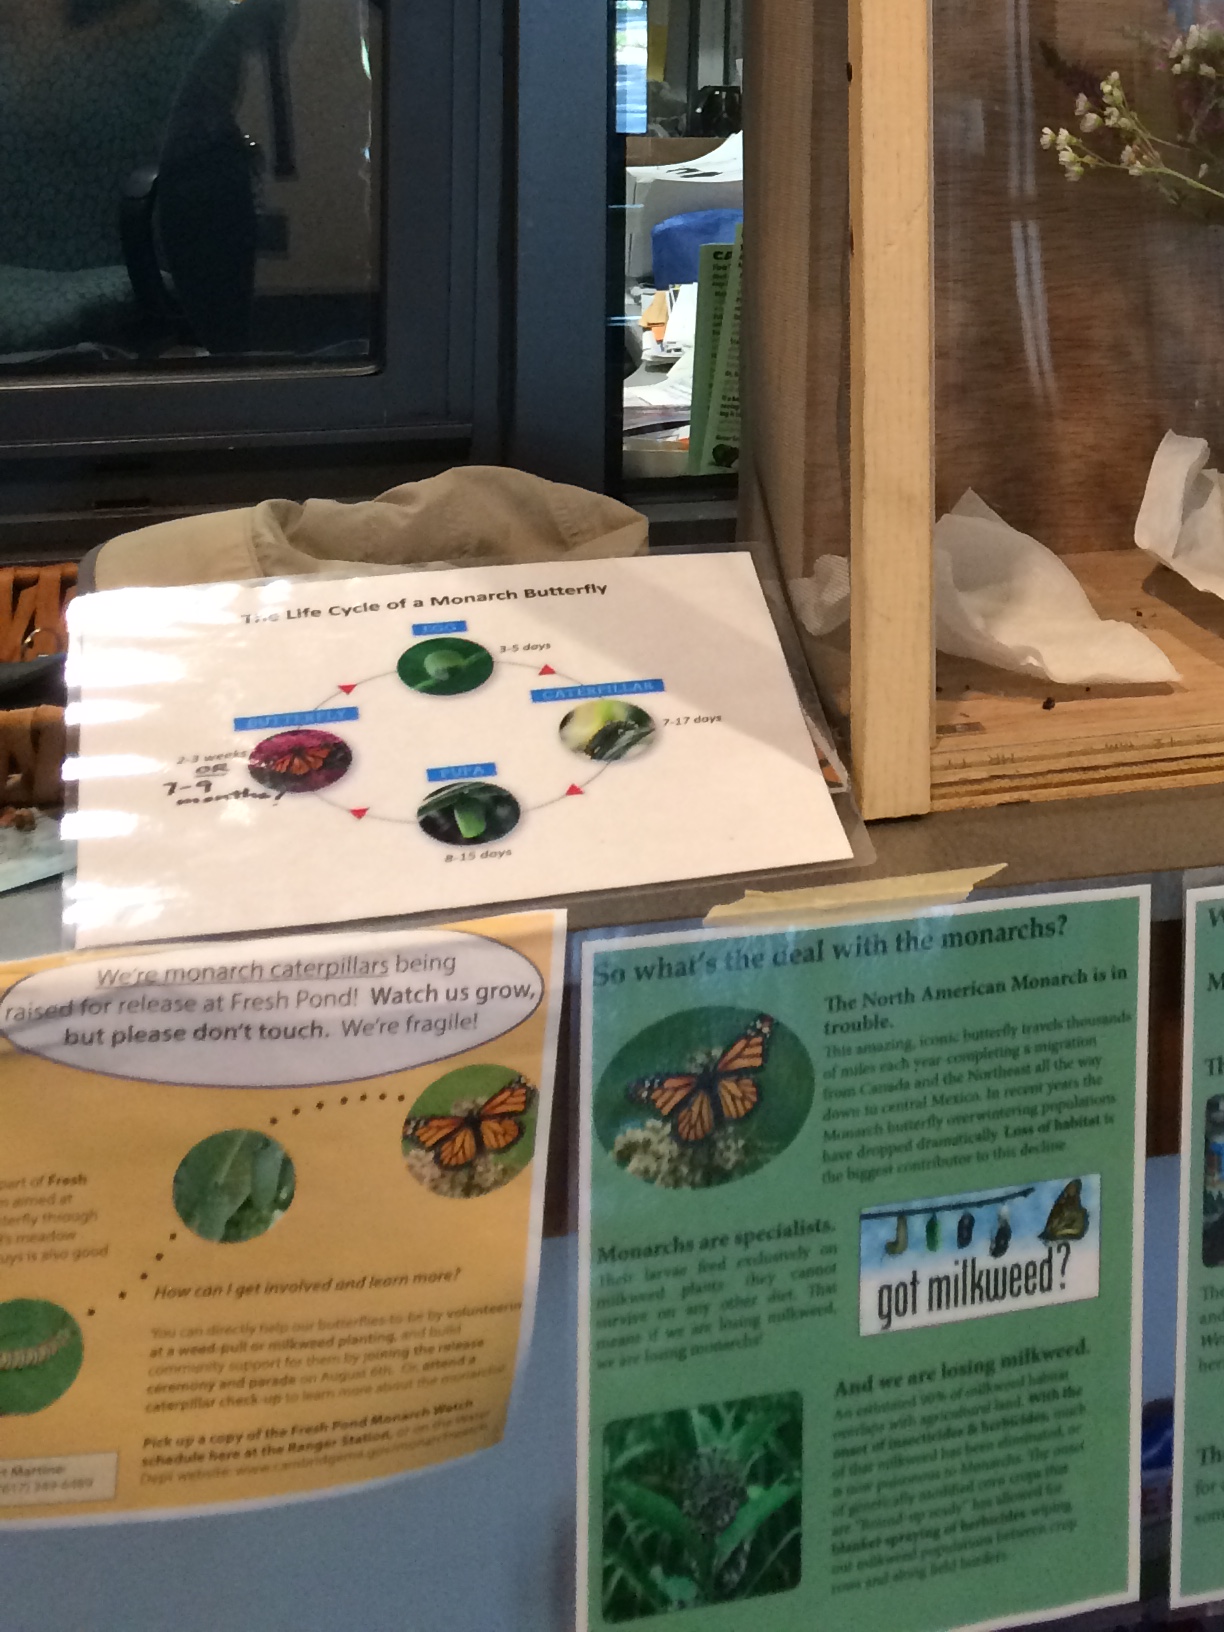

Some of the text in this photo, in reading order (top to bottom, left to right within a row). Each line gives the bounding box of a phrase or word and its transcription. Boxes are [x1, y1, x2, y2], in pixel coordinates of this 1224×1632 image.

[286, 606, 321, 621] Life
[328, 599, 380, 618] Cycle
[386, 597, 407, 611] of
[413, 597, 424, 608] a
[430, 589, 519, 607] Monarch
[524, 582, 608, 600] Butterfly
[499, 641, 552, 654] 3-5 days
[542, 681, 654, 701] CATERPILLAR
[693, 714, 723, 725] days
[204, 749, 249, 762] weeks
[479, 848, 512, 860] days
[592, 914, 1067, 986] So what's the deal with the monarchs?
[98, 954, 457, 988] We're monarch caterpillars being
[823, 964, 1127, 1012] The North American Monarch is in
[1, 983, 538, 1027] raised for release at Fresh Pond! Watch us grow,
[62, 1012, 477, 1047] but please don't touch. We're fragile!
[823, 1014, 893, 1034] trouble.
[878, 1243, 1072, 1330] got milkweed?
